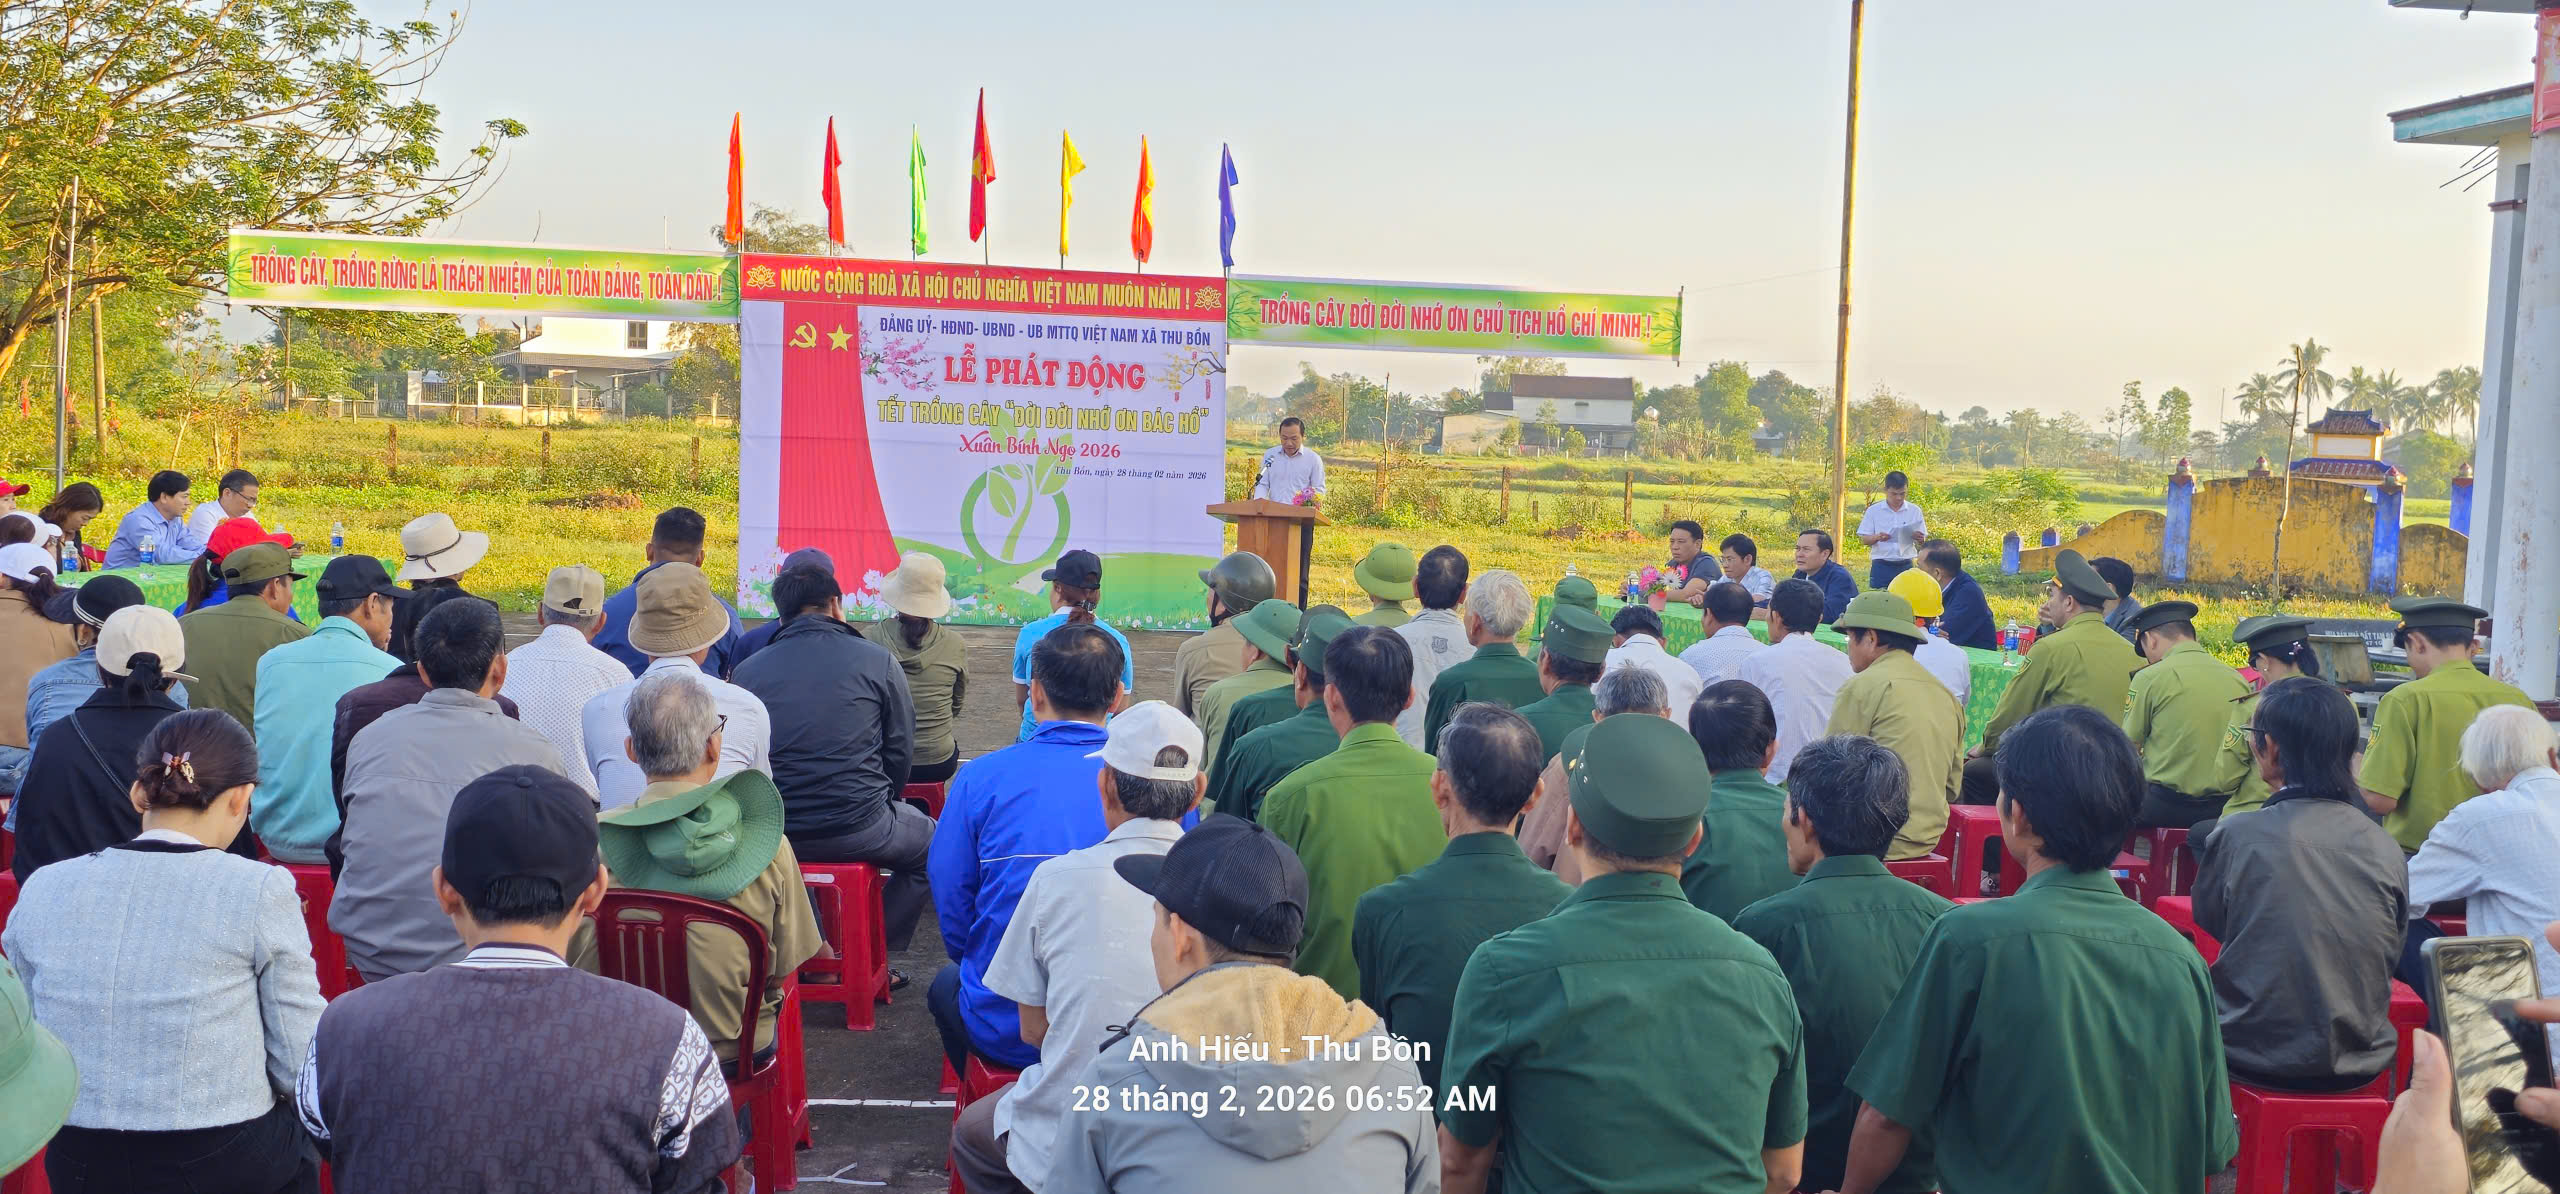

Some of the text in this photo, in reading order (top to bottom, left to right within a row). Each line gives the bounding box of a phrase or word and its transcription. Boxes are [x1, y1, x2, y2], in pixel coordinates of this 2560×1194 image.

[300, 251, 328, 289] CÂY,
[381, 255, 418, 289] RỪNG
[421, 257, 438, 291] LÀ
[441, 258, 485, 293] TRÁCH
[488, 260, 532, 301] NHIỆM
[536, 258, 563, 296] CỦA
[566, 263, 601, 297] TOÀN
[604, 262, 645, 302] ĐẢNG,
[649, 266, 683, 300] TOÀN
[685, 268, 713, 301] DÂN
[780, 264, 820, 293] NƯỚC
[824, 266, 864, 299] CỘNG
[868, 269, 898, 297] HOÀ
[901, 271, 921, 298] XÃ
[924, 272, 949, 303] HỘI
[952, 270, 981, 300] CHỦ
[985, 275, 1029, 303] NGHĨA
[1032, 277, 1062, 309] VIỆT
[1065, 281, 1099, 306] NAM
[1102, 280, 1145, 308] MUÔN
[1148, 281, 1181, 310] NĂM
[880, 313, 913, 333] ĐẢNG
[941, 319, 979, 336] HĐND-
[982, 321, 1015, 338] UBND
[1027, 324, 1043, 339] UB
[1047, 324, 1079, 342] MTTQ
[1082, 323, 1107, 345] VIỆT
[1110, 327, 1138, 343] NAM
[1141, 327, 1157, 344] XÃ
[1161, 329, 1183, 345] THU
[1315, 297, 1345, 328] CÂY
[1350, 298, 1376, 328] ĐỜI
[1380, 299, 1406, 330] ĐỜI
[1410, 302, 1443, 331] NHỚ
[1447, 304, 1469, 332] ƠN
[1473, 301, 1503, 333] CHỦ
[1508, 308, 1542, 339] TỊCH
[1546, 304, 1566, 336] HỒ
[1571, 307, 1596, 337] CHÍ
[1600, 312, 1641, 338] MINH
[943, 343, 1146, 396] LỄ PHÁT ĐỘNG
[877, 393, 907, 423] TẾT
[968, 399, 1001, 427] CÂY
[1045, 402, 1073, 429] ĐỜI
[1076, 404, 1111, 431] NHỚ
[1115, 407, 1138, 432] ƠN
[1141, 407, 1174, 433] BÁC
[959, 430, 1002, 454] Xuân
[1043, 436, 1076, 463] Ngọ
[1079, 443, 1121, 458] 2026
[1055, 466, 1072, 475] Thu
[1094, 468, 1114, 479] ngày
[1116, 469, 1127, 477] 28
[1154, 470, 1165, 478] 02
[1187, 471, 1207, 480] 2026
